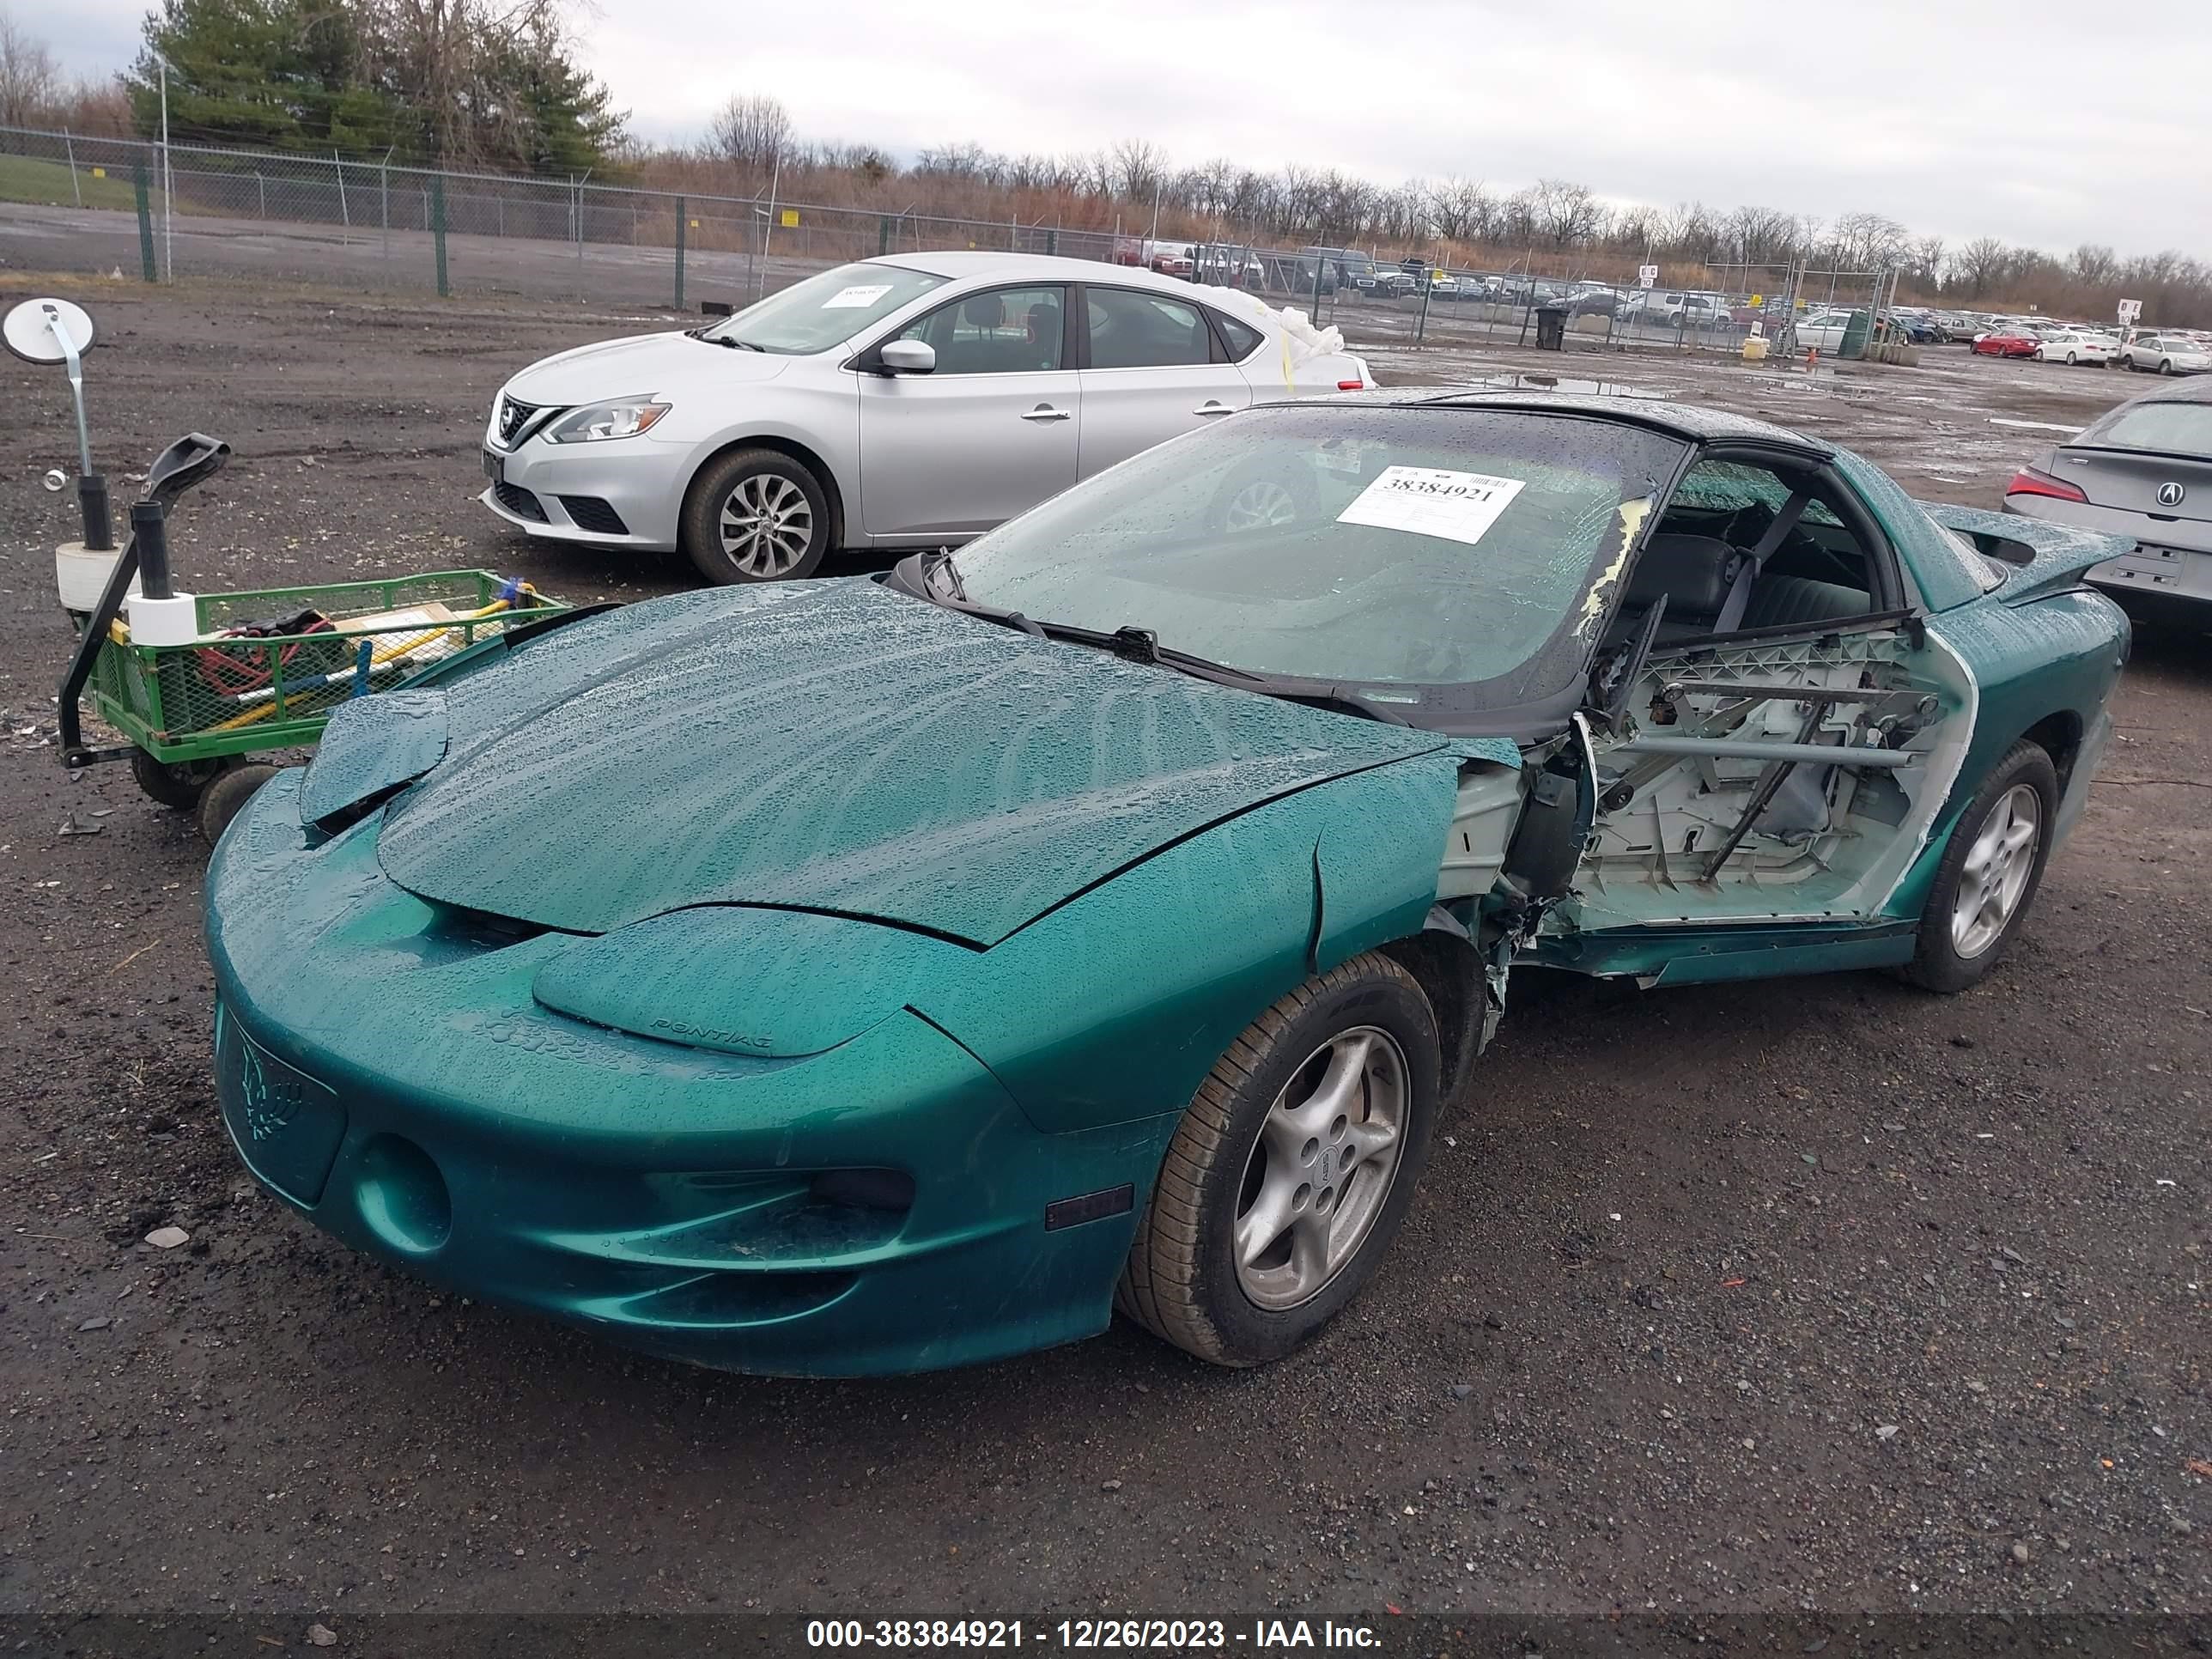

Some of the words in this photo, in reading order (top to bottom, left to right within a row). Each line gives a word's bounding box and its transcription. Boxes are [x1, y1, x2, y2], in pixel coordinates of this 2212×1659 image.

[1650, 267, 1656, 276] C
[1383, 478, 1493, 502] 38384921
[649, 1017, 773, 1048] PONTIAC
